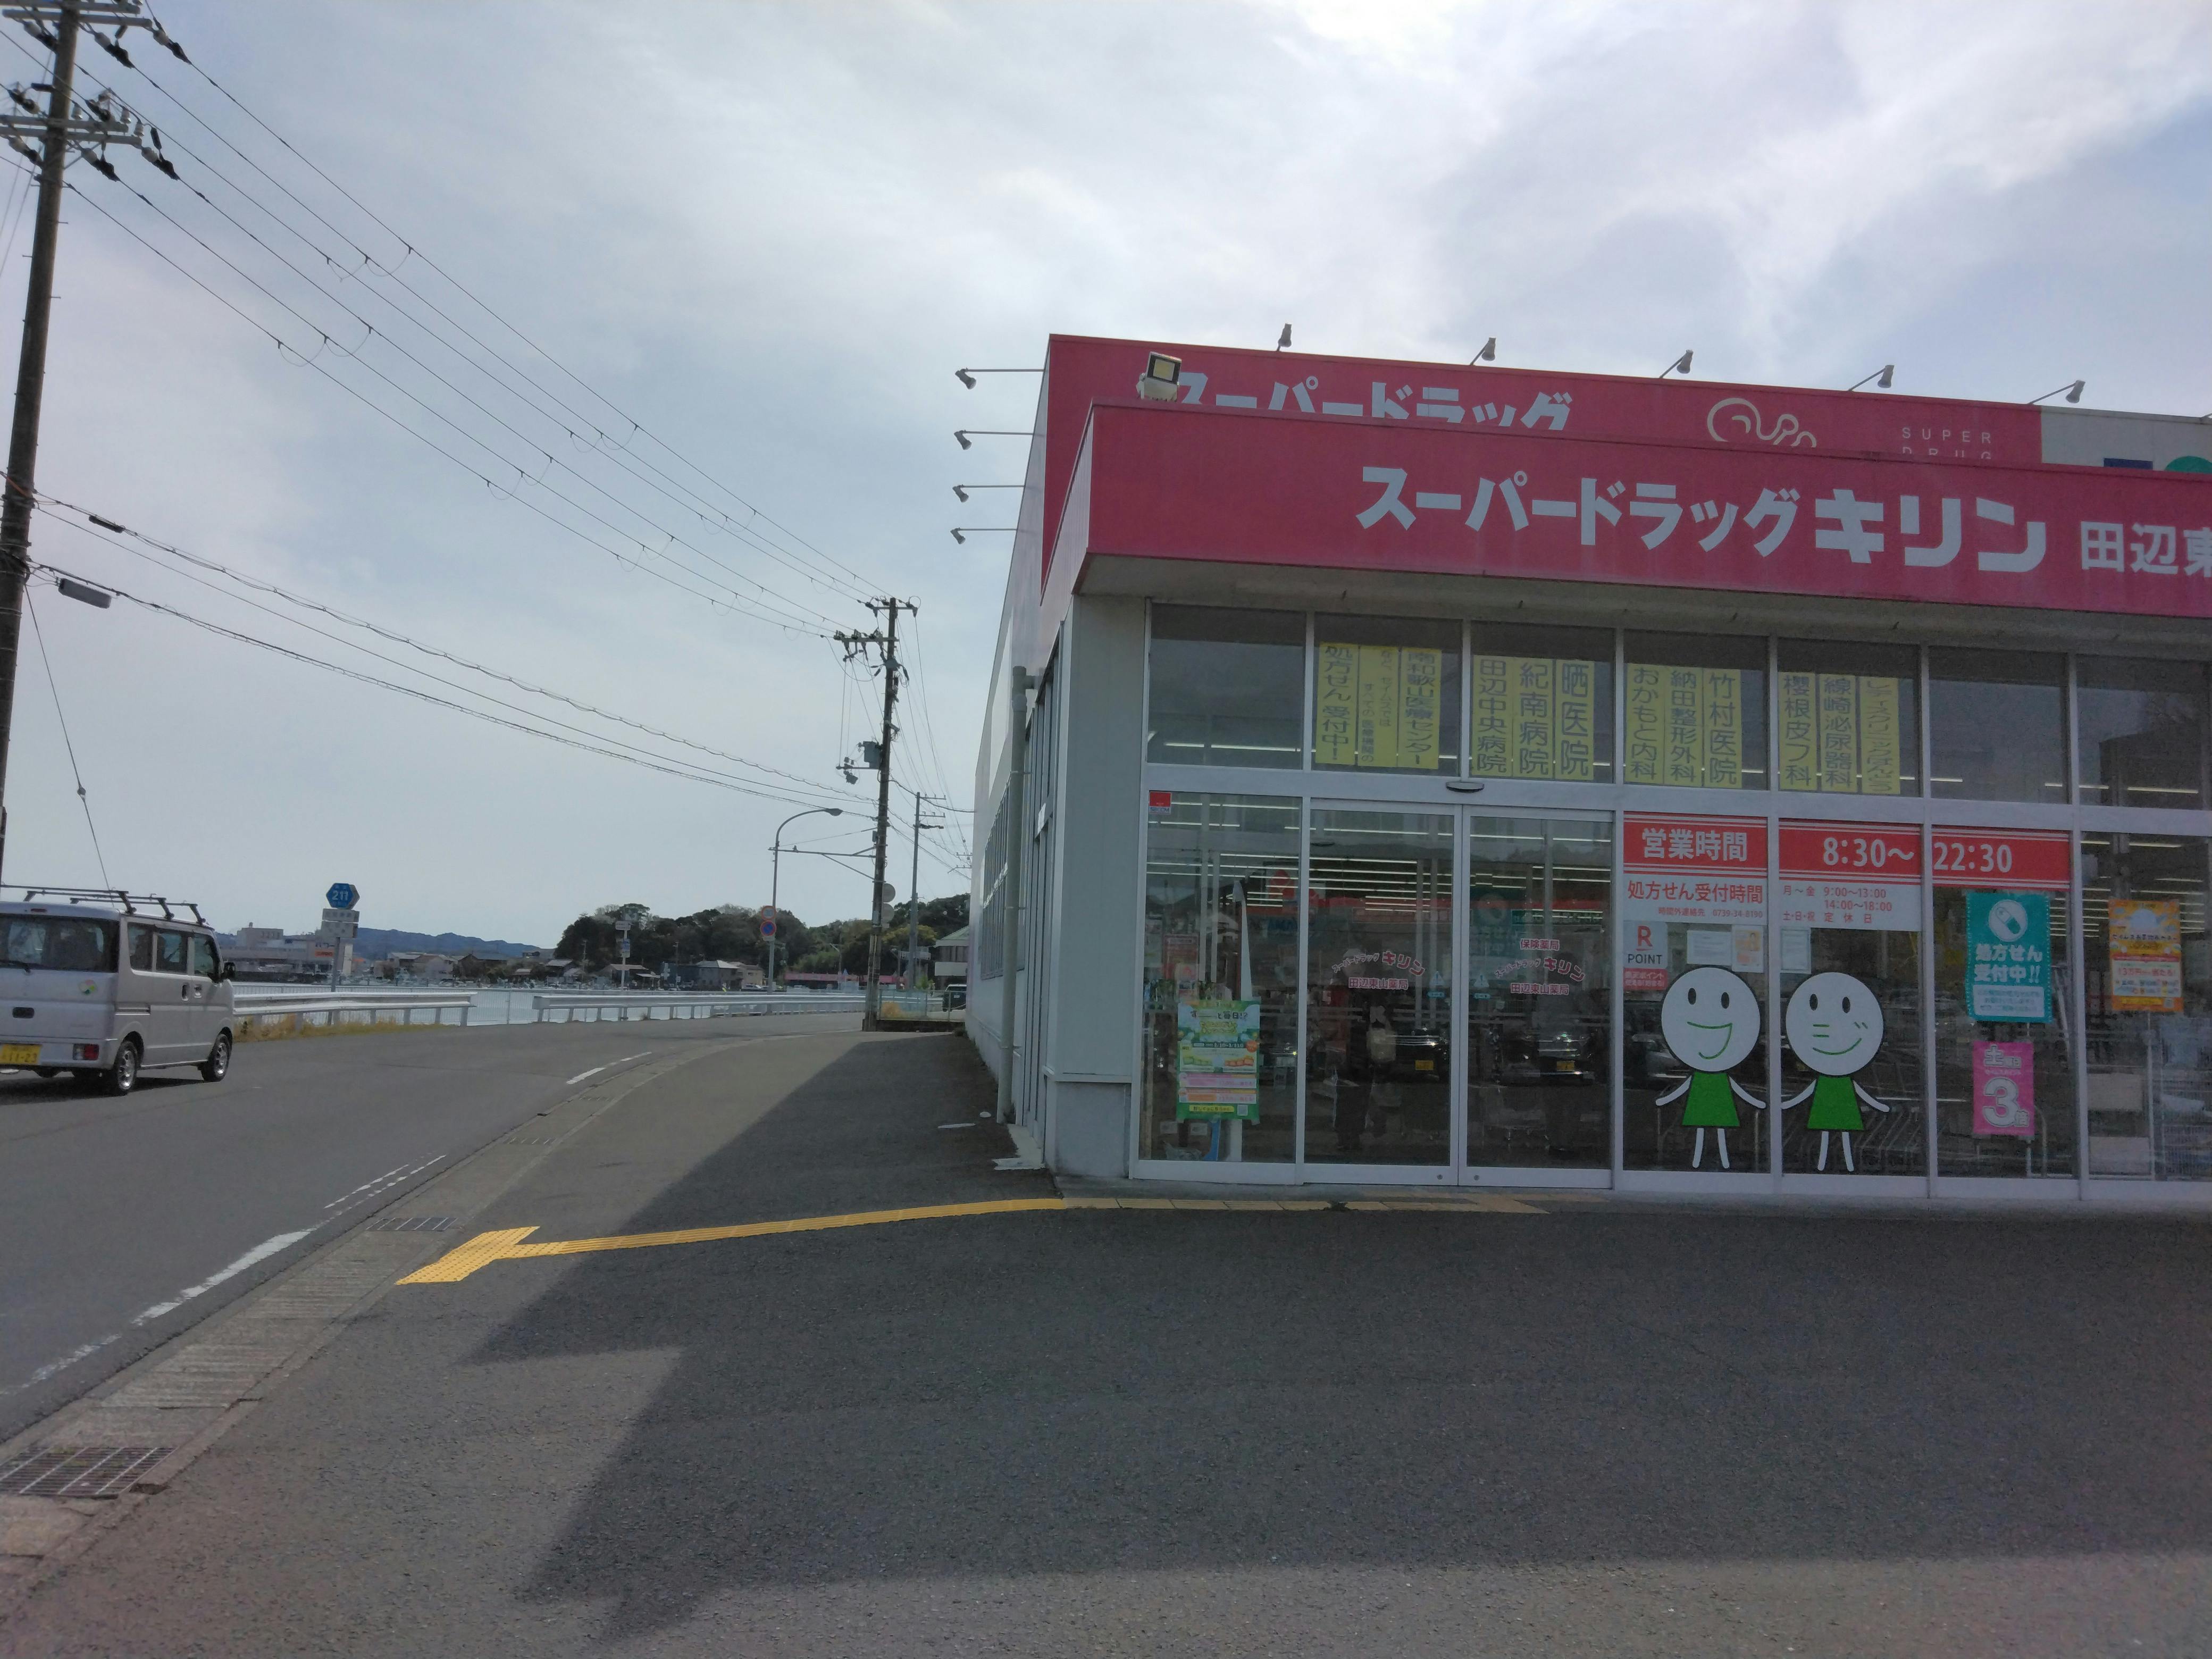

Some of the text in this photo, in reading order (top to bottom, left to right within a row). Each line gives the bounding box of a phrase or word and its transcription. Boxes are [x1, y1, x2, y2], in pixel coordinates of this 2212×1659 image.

[1901, 427, 1991, 444] SUPER
[1477, 659, 1507, 774] 田辺中央病院
[1519, 661, 1549, 775] 紀南病院
[1631, 667, 1660, 781] おかもと内科
[1670, 671, 1697, 783] 納田整形外科
[1709, 673, 1737, 784] 竹村医院
[1642, 828, 1747, 862] 営業時間
[1933, 842, 2013, 873] 22:30
[1627, 879, 1763, 904] 処方せん受付時間
[1520, 939, 1560, 951] 保険薬局
[1974, 943, 2043, 962] 処方せん
[1628, 953, 1663, 964] POINT
[1348, 977, 1409, 990] 田辺東山薬局
[1510, 983, 1570, 995] 田辺東山薬局
